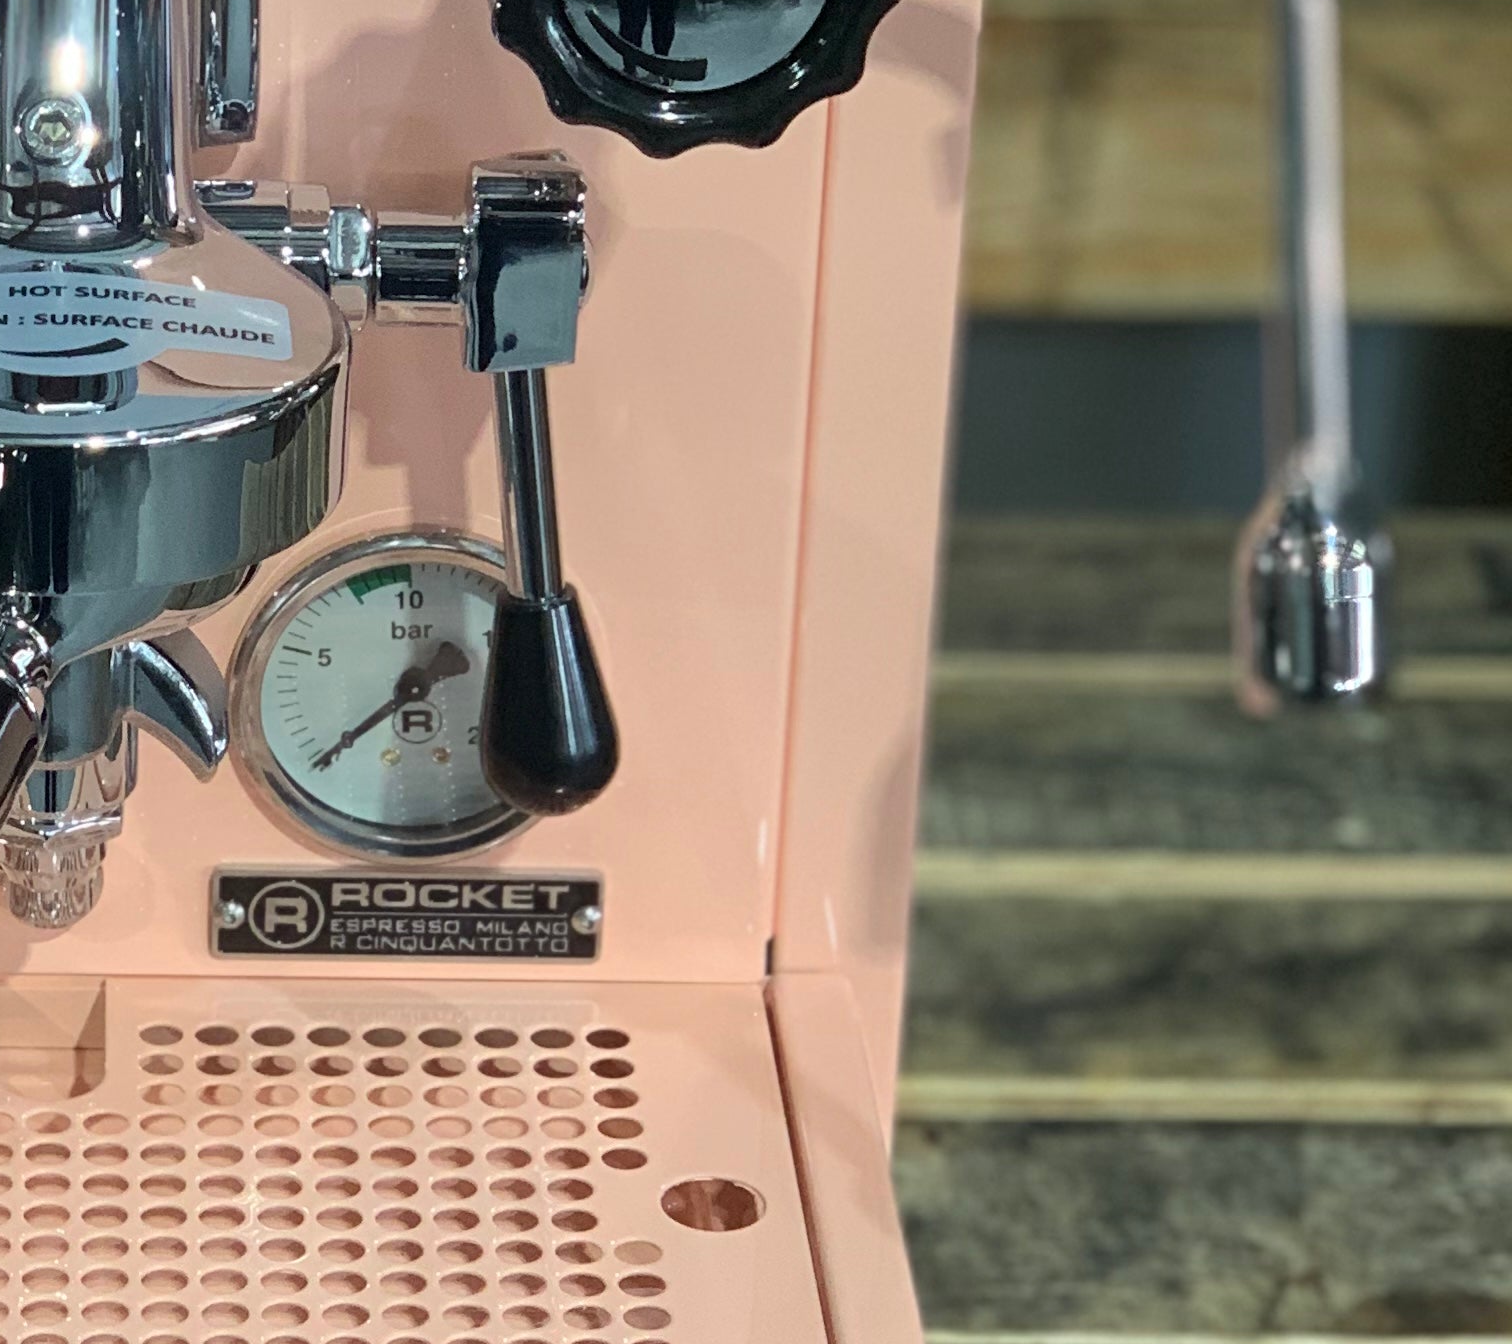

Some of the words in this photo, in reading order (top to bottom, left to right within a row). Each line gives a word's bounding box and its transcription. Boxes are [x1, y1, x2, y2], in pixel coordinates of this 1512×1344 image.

[8, 284, 68, 298] HOT
[74, 286, 197, 309] SURFACE
[34, 312, 153, 331] SURFACE
[162, 320, 275, 345] CHAUDE
[395, 589, 424, 609] 10
[391, 620, 433, 641] bar
[317, 648, 332, 668] 5
[401, 710, 434, 733] R
[263, 897, 308, 933] R
[330, 882, 571, 910] ROCKET
[330, 917, 461, 934] ESPRESSO
[475, 920, 569, 936] MILANO
[330, 935, 346, 950] R
[356, 935, 569, 953] CINQUANTOTTO
